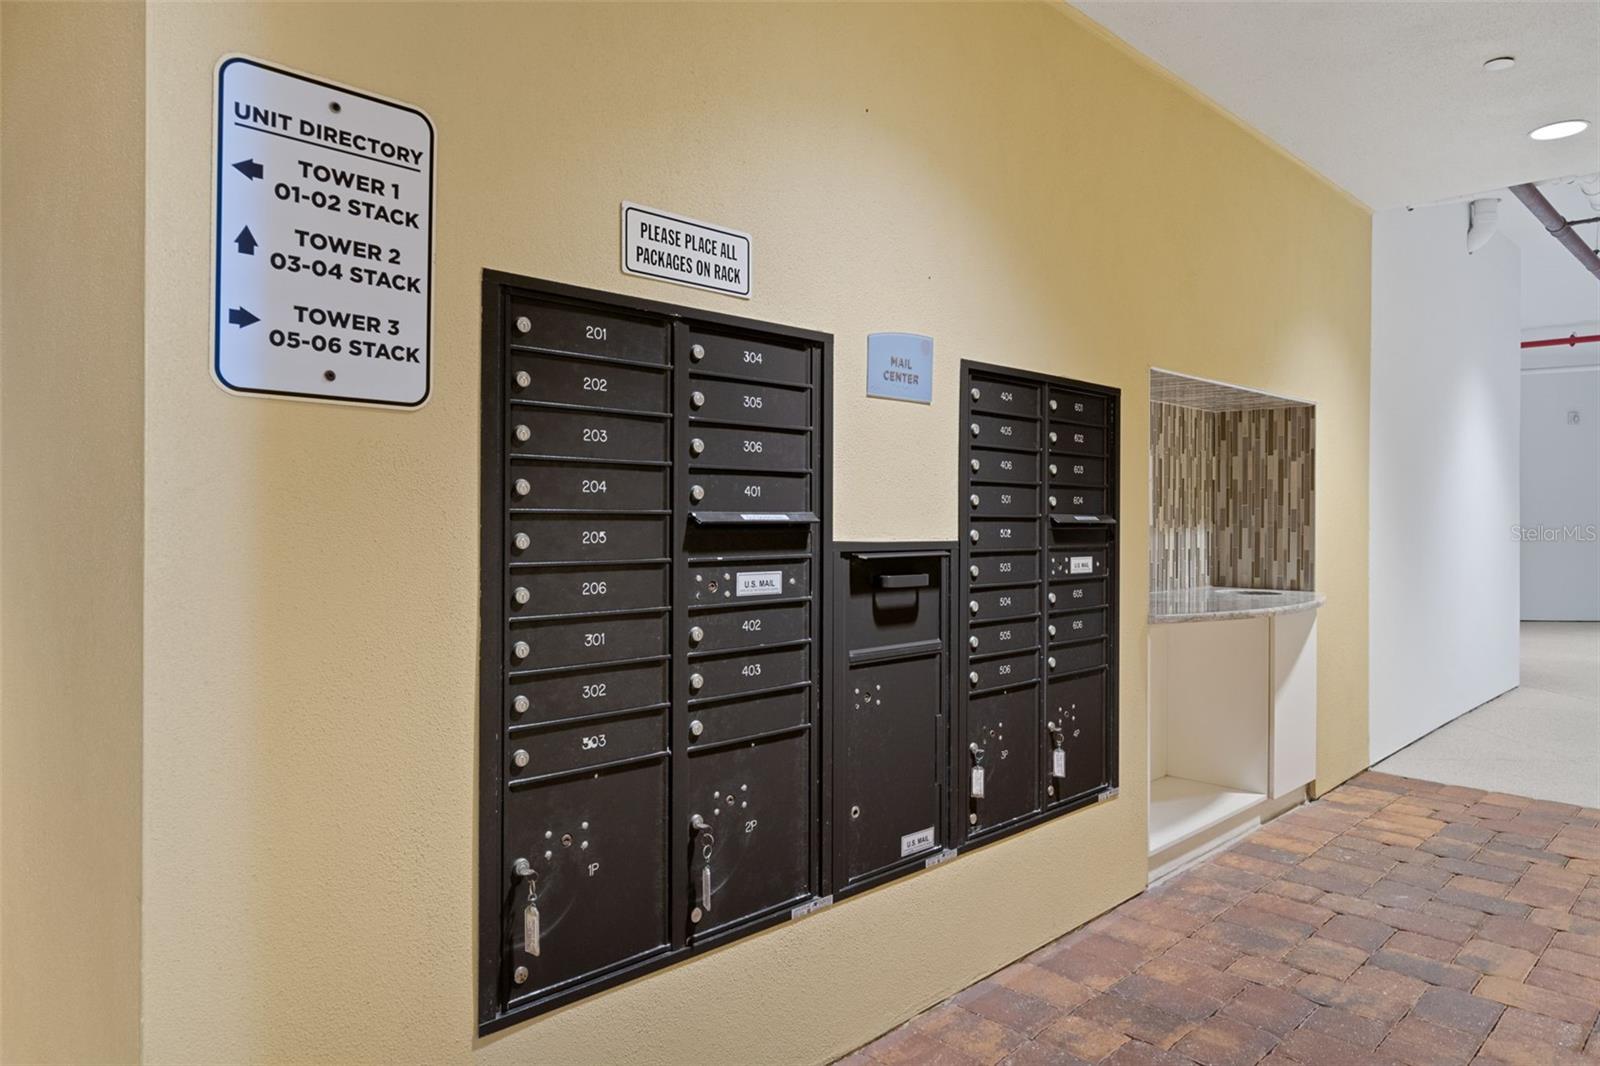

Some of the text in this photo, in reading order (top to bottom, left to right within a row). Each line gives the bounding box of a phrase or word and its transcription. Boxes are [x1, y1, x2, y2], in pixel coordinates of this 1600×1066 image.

[234, 101, 424, 166] UNIT DIRECTORY
[298, 160, 400, 200] TOWER 1
[273, 182, 420, 230] 01-02 STACK
[294, 229, 401, 265] TOWER 2
[640, 221, 738, 261] PLEASE PLACE ALL
[636, 245, 741, 285] PACKAGES ON RACK
[270, 252, 422, 294] 03-04 STACK
[293, 305, 400, 336] TOWER 3
[585, 326, 606, 341] 201
[268, 328, 421, 364] 05-06 STACK
[743, 351, 762, 364] 304
[890, 355, 912, 370] MAIL
[583, 377, 607, 392] 202
[883, 370, 919, 385] CENTER
[743, 396, 762, 409] 305
[1000, 391, 1013, 402] 404
[583, 429, 607, 443] 203
[743, 441, 762, 453] 306
[1000, 460, 1013, 470] 406
[582, 480, 606, 493] 204
[744, 486, 760, 497] 401
[1001, 494, 1012, 504] 501
[582, 531, 606, 544] 205
[999, 562, 1012, 573] 503
[582, 582, 606, 596] 206
[744, 579, 776, 589] U.S. MAIL
[999, 596, 1012, 607] 504
[742, 620, 760, 632] 402
[584, 633, 604, 647] 301
[741, 664, 761, 677] 403
[999, 664, 1011, 675] 506
[582, 684, 606, 699] 302
[745, 820, 757, 833] 2P
[917, 835, 929, 845] MAIL
[587, 863, 599, 877] 1P
